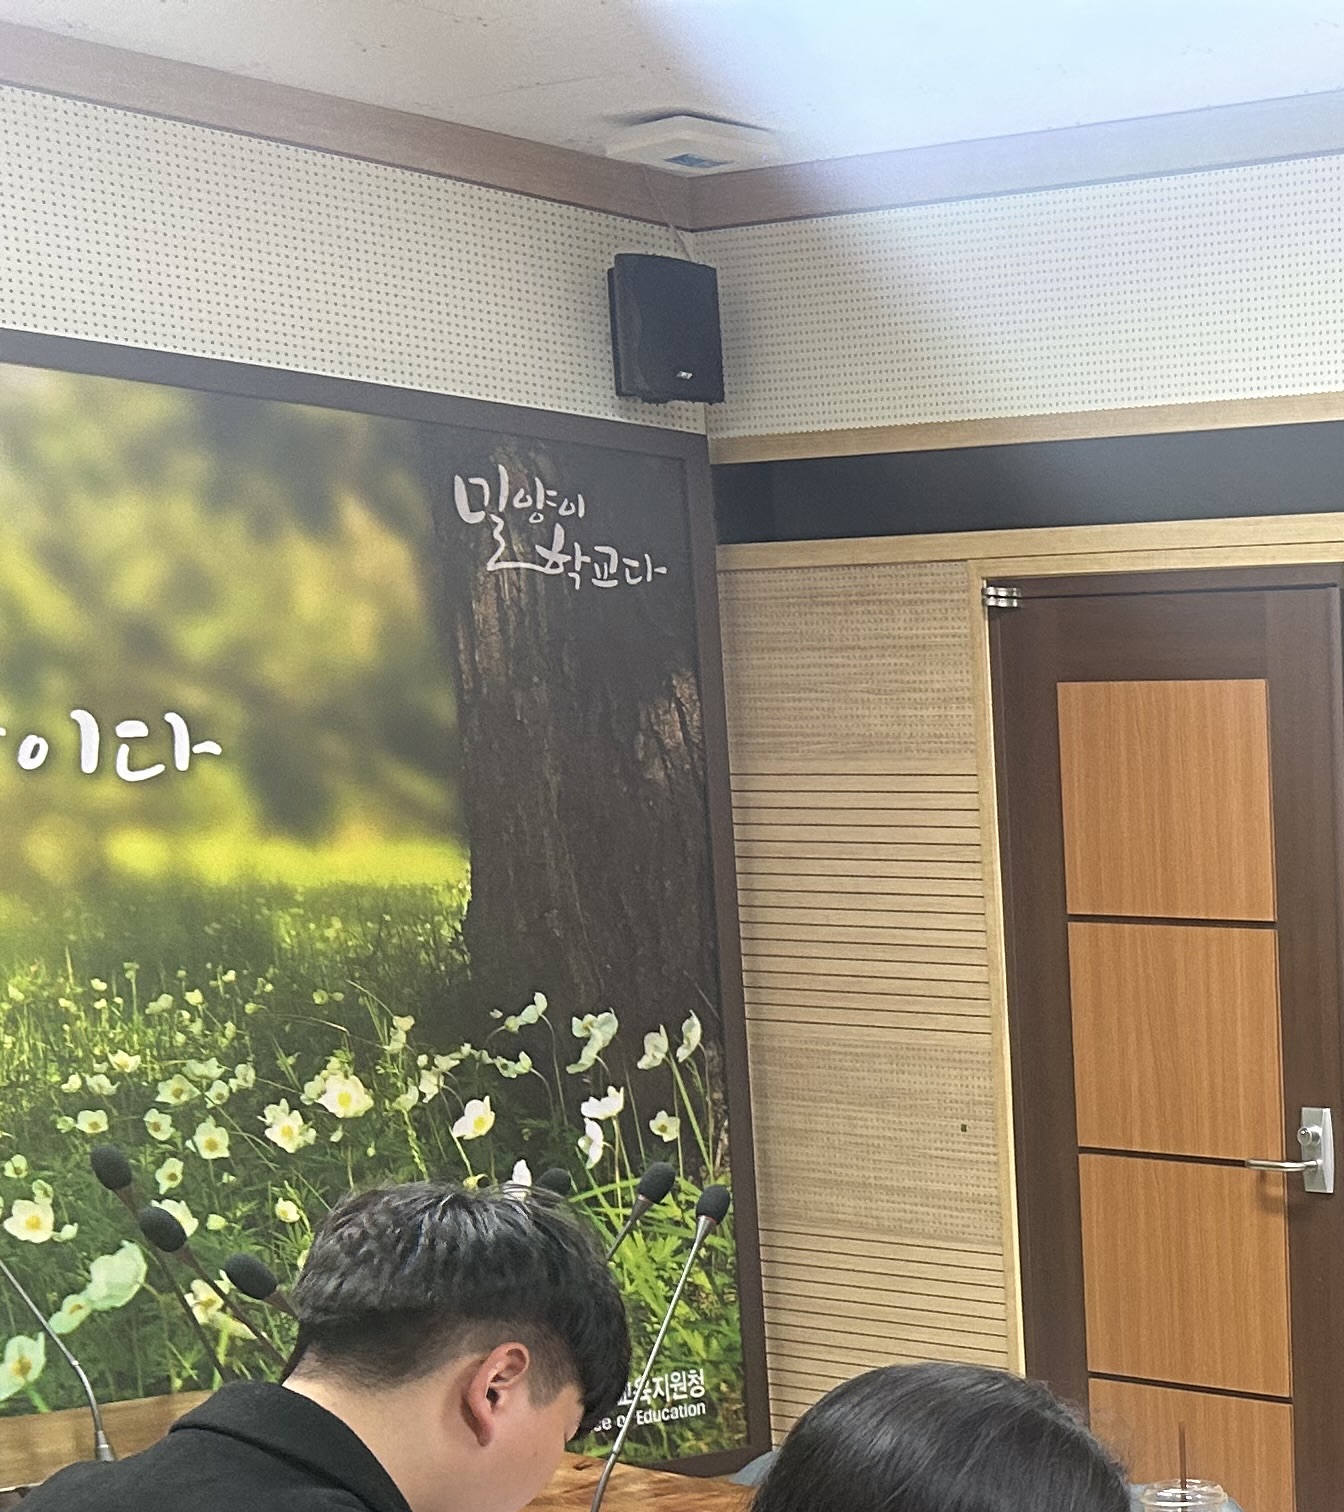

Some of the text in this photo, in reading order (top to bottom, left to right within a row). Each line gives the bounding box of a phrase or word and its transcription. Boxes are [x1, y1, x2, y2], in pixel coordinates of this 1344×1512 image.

[454, 463, 586, 571] 밀양이
[535, 523, 668, 590] 학교다
[0, 709, 223, 782] 이다
[636, 1402, 706, 1426] Education
